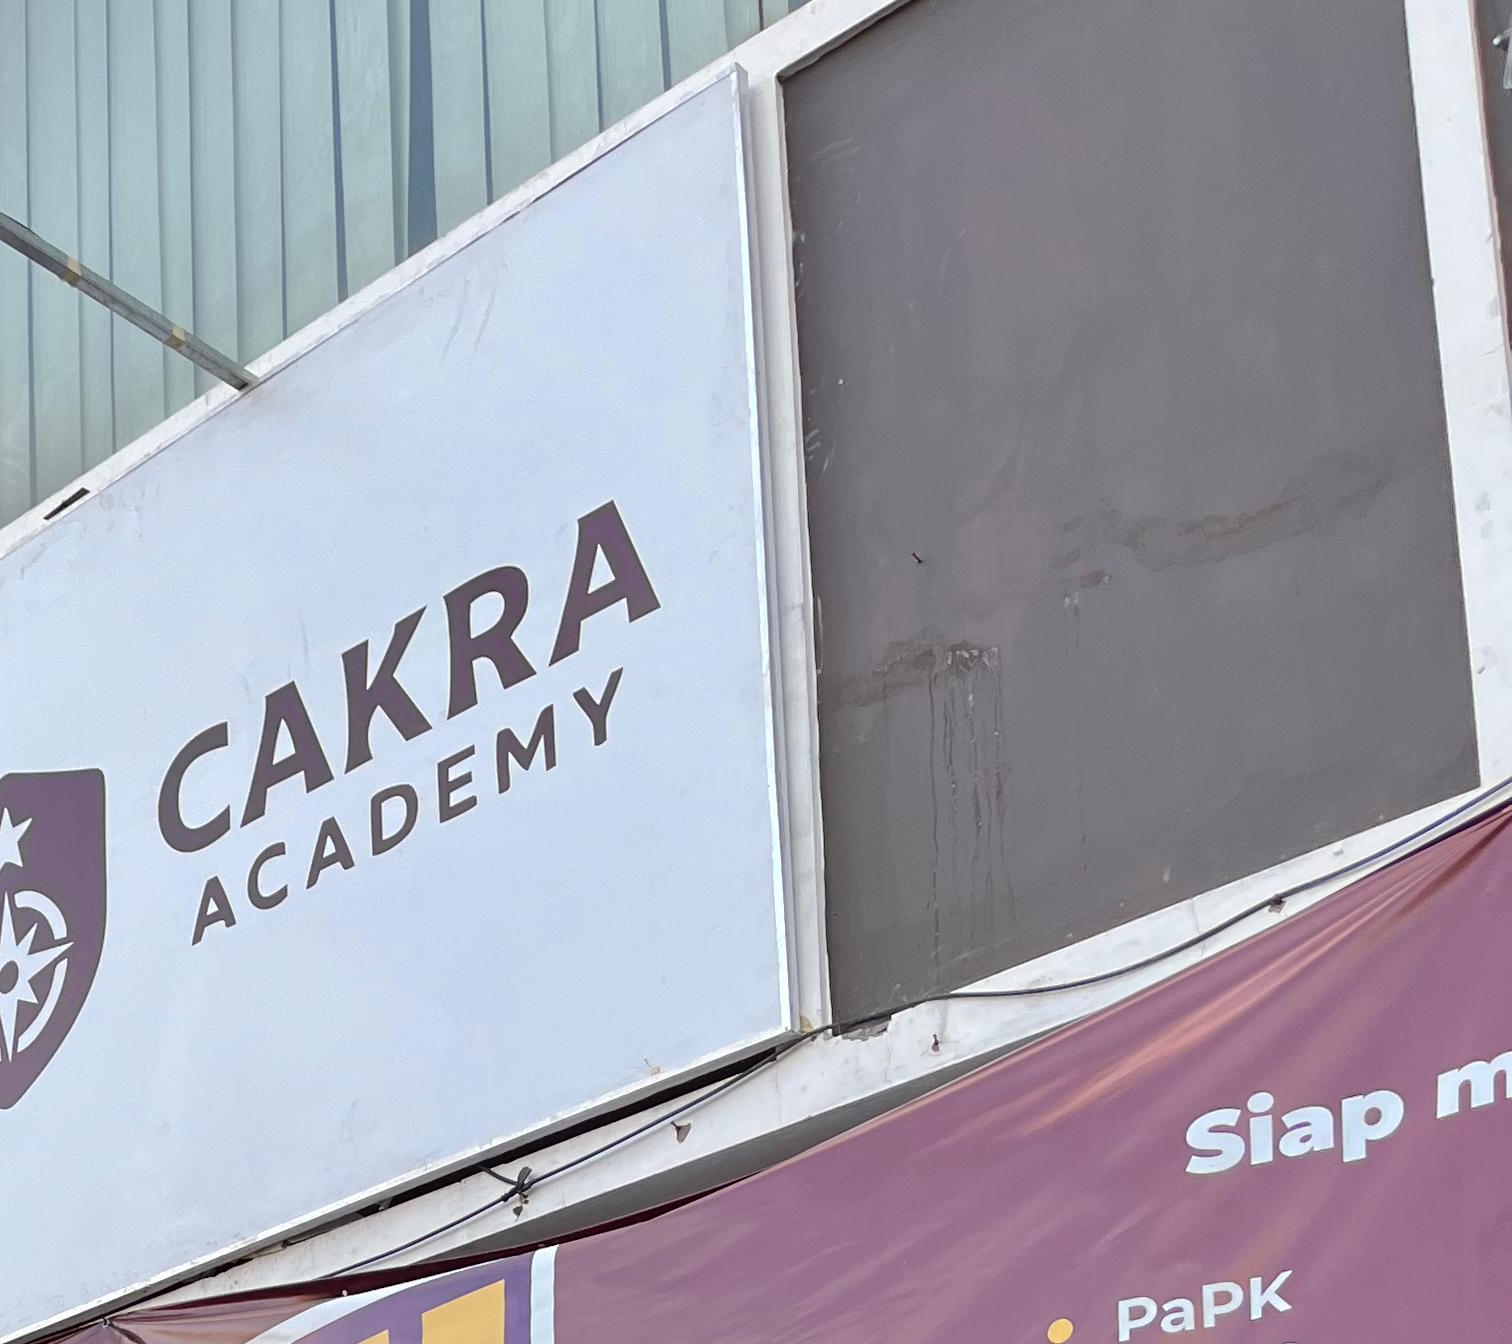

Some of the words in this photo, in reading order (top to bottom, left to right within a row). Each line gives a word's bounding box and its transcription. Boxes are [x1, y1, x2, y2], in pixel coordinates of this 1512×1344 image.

[157, 498, 662, 853] CAKRA
[191, 666, 624, 946] ACADEMY
[1185, 1088, 1405, 1175] Siap
[1436, 1050, 1512, 1119] m
[1117, 1269, 1293, 1342] PaPK
